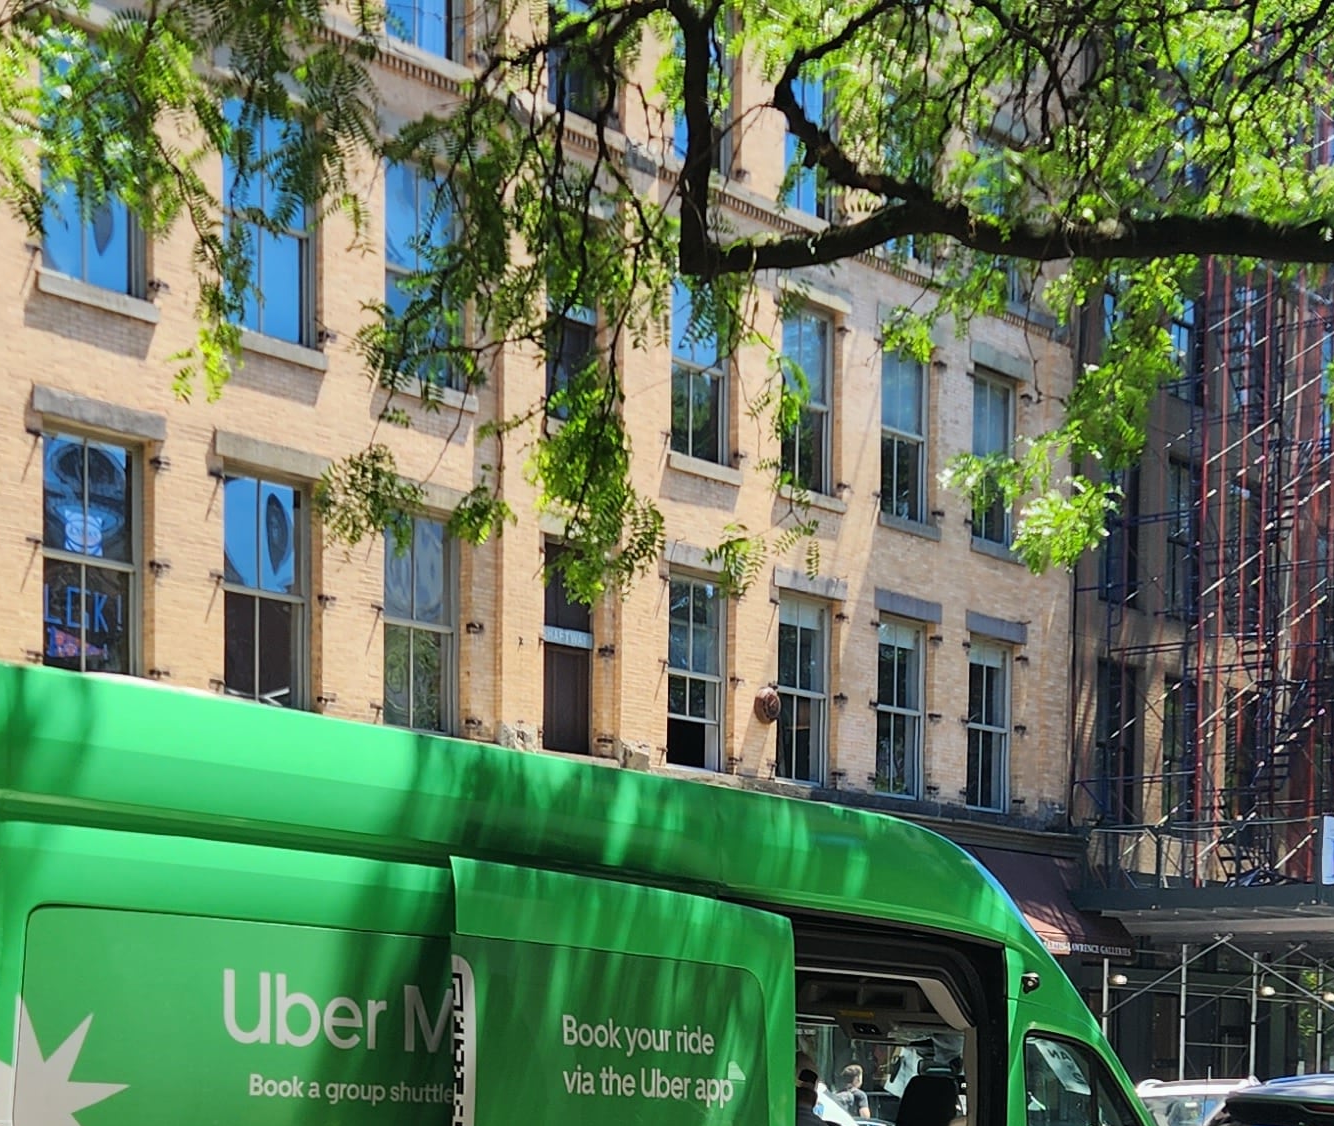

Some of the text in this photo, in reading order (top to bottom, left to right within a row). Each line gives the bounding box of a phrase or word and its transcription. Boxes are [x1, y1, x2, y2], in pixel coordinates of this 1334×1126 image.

[222, 967, 387, 1051] Uber
[562, 1014, 716, 1058] Book your ride
[248, 1072, 455, 1107] Book a group shuttle
[562, 1063, 735, 1110] via the Uber app
